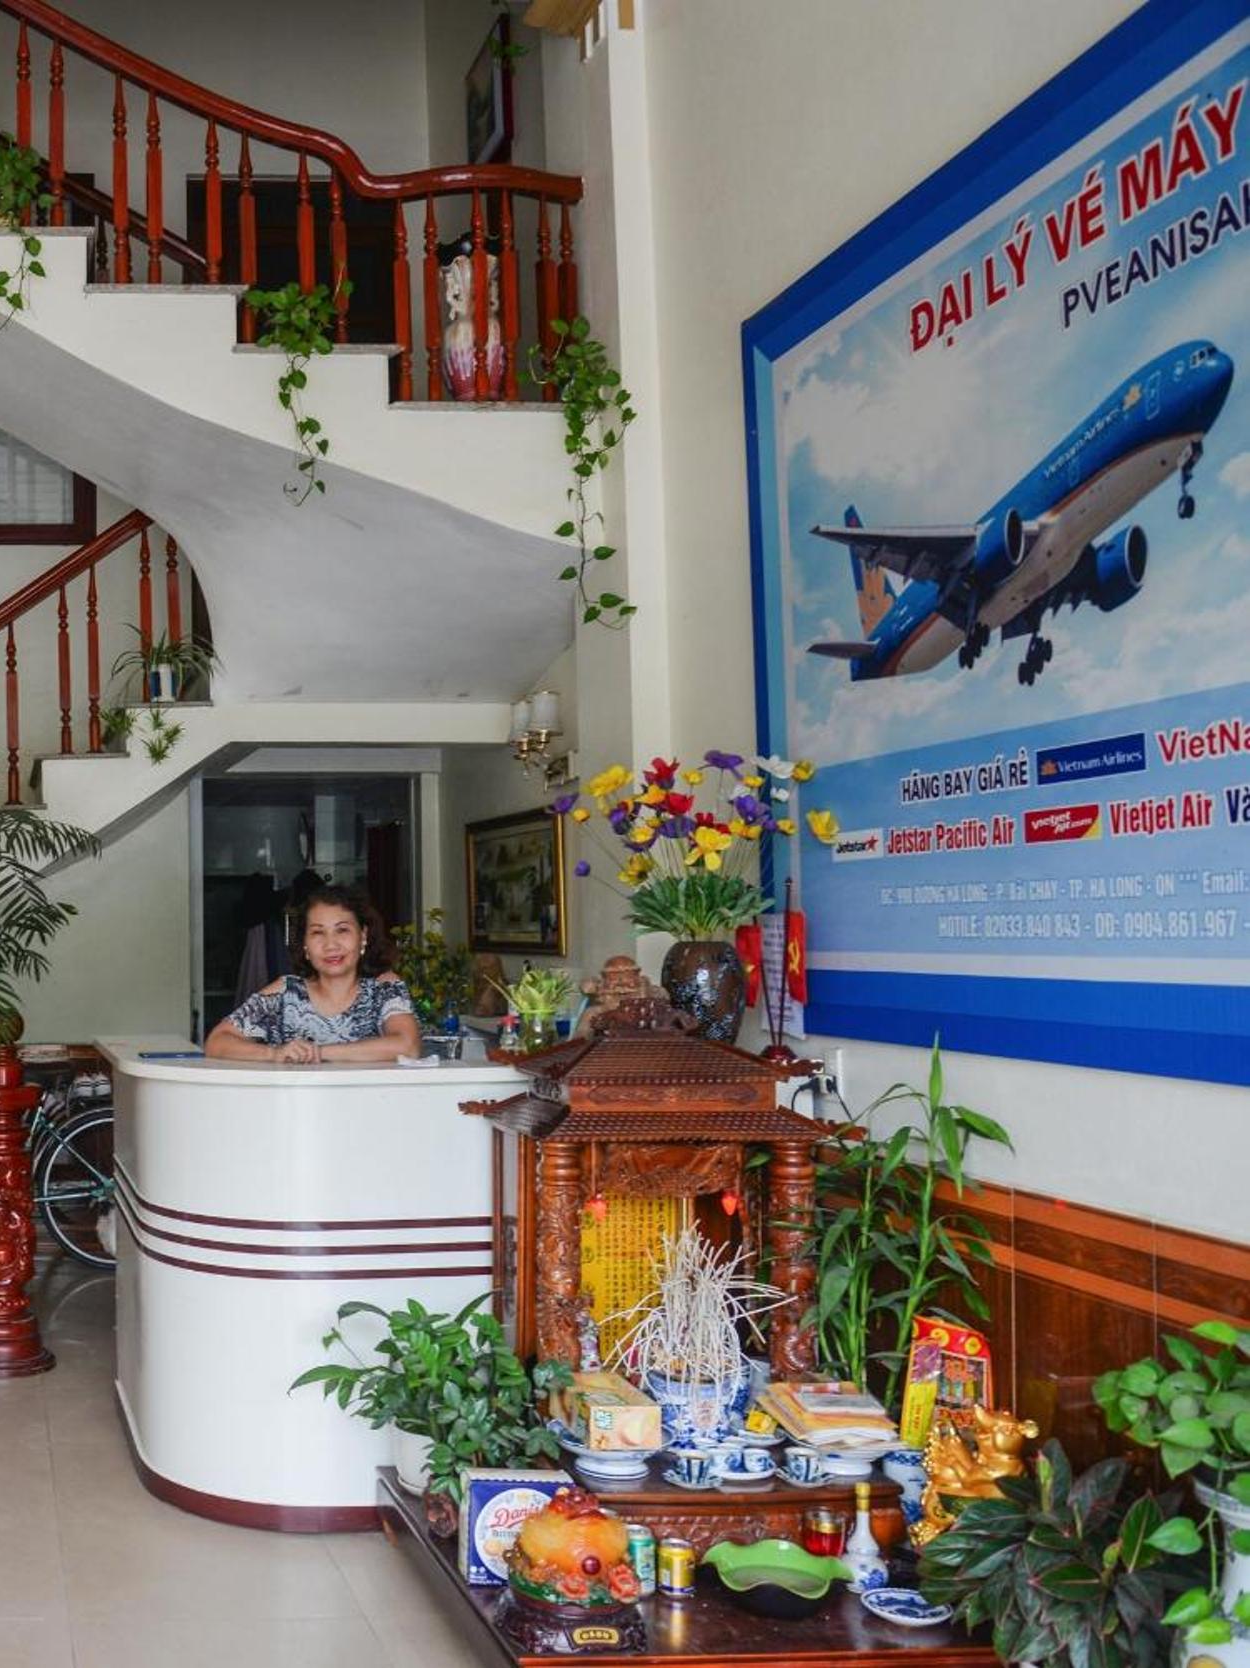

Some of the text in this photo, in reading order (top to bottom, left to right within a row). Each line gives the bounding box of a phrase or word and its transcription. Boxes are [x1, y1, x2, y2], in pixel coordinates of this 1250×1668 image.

[910, 85, 1243, 351] ĐẠI LÝ VÉ MÁY
[944, 769, 973, 796] BAY
[978, 757, 1005, 791] GIÁ
[1009, 750, 1028, 788] RẺ
[1110, 798, 1175, 834] Vietjet
[1182, 793, 1213, 827] Air
[888, 817, 1014, 854] Jetstar Pacific Air
[1110, 876, 1142, 898] LONG
